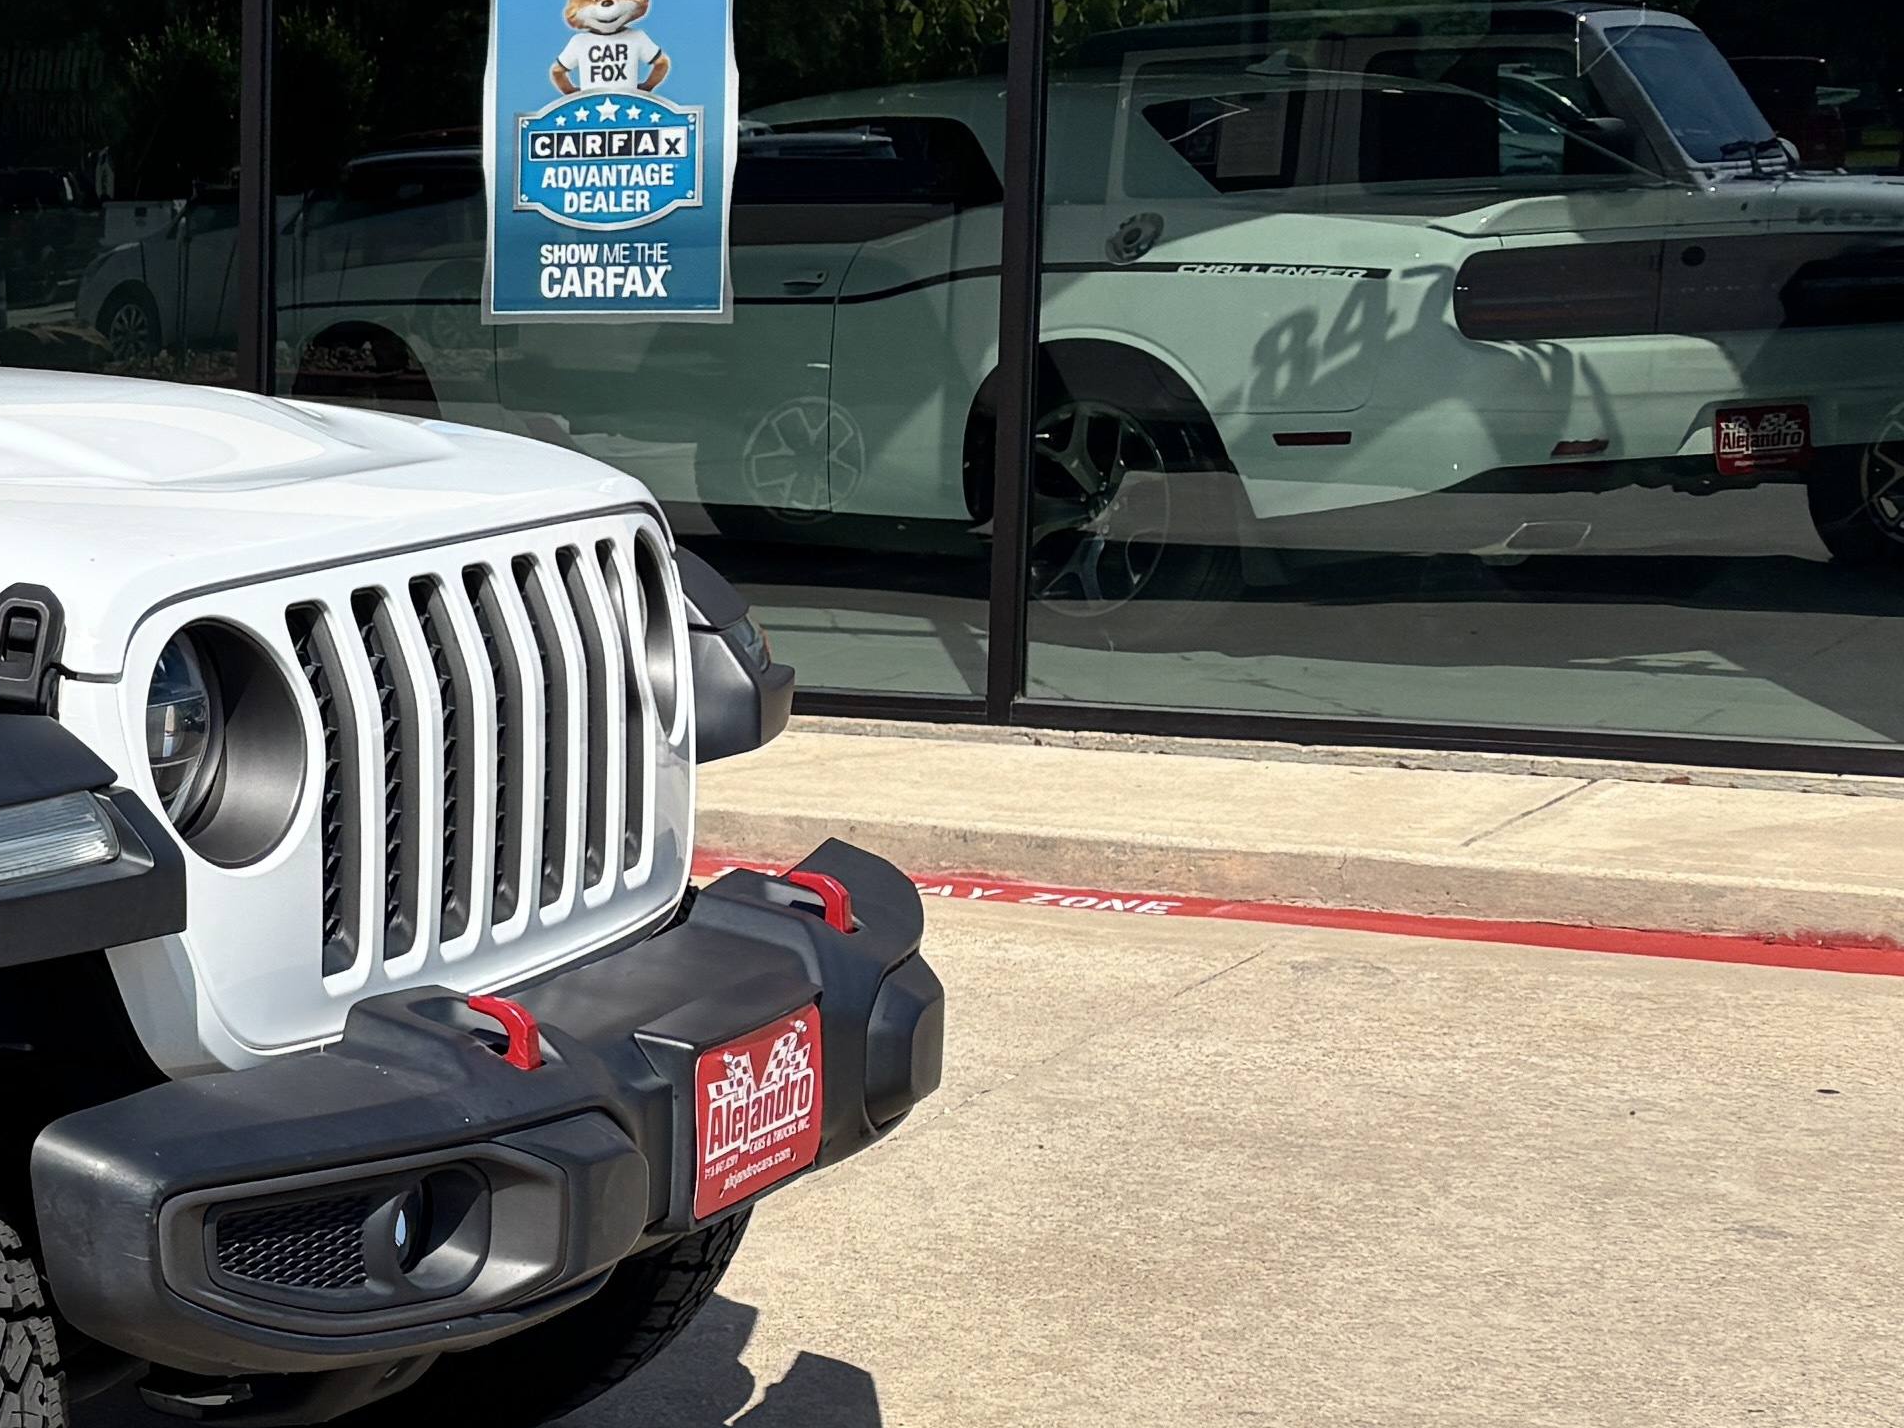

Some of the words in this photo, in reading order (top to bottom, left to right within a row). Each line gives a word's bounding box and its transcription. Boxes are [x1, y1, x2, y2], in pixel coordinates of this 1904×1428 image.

[588, 43, 628, 63] CAR
[590, 63, 628, 84] FOX
[531, 130, 685, 159] CARFAX
[541, 163, 674, 190] ADVANTAGE
[563, 189, 651, 214] DEALER
[540, 243, 598, 265] SHOW
[603, 244, 630, 265] ME
[633, 242, 669, 264] THE
[540, 265, 669, 299] CARFAX
[1176, 263, 1369, 279] CHALLENGER
[1721, 428, 1805, 455] Alejandro
[1019, 891, 1184, 915] ZONE
[706, 1068, 814, 1163] Alejandro
